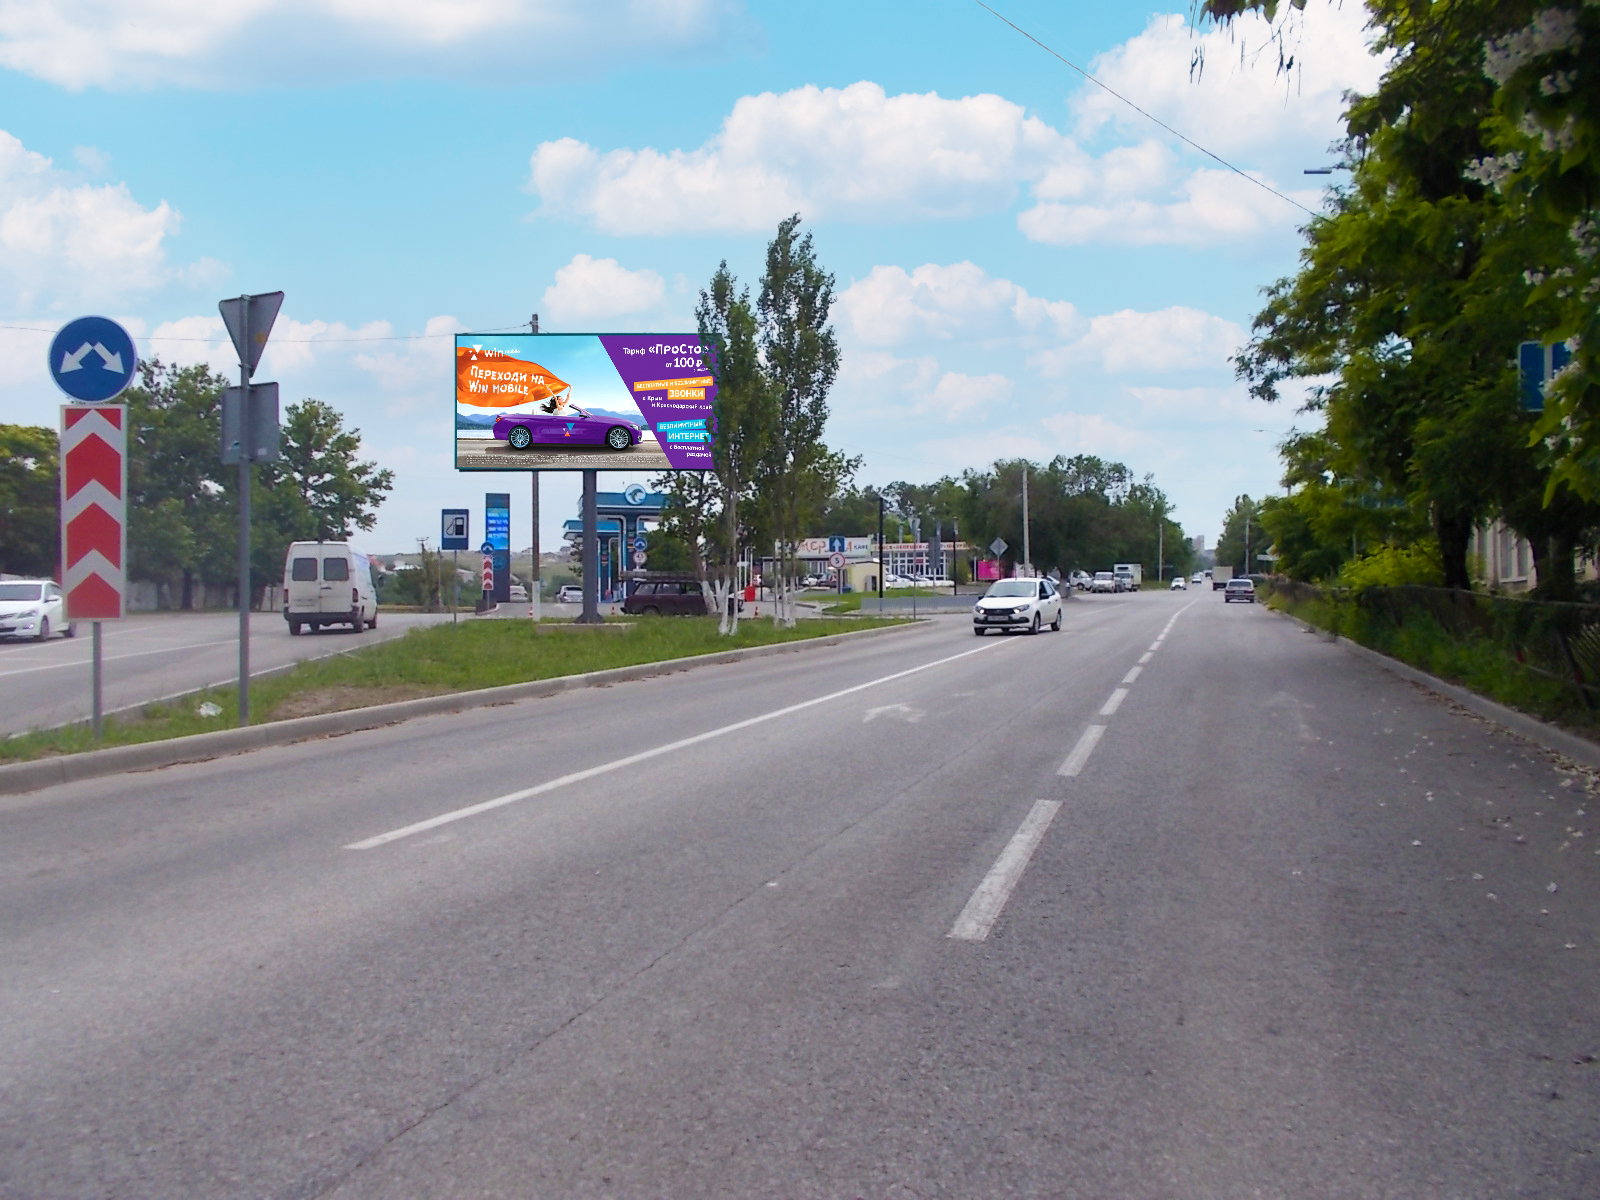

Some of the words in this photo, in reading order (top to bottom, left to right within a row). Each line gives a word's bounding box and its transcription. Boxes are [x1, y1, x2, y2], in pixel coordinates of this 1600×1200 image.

[484, 347, 504, 358] win
[623, 347, 646, 356] Тариф
[673, 357, 694, 368] 100
[669, 389, 704, 398] ЗВОНКИ
[659, 420, 703, 430] БЕЗЛИМИТНЫЙ
[668, 432, 710, 440] ИНТЕРНЕТ
